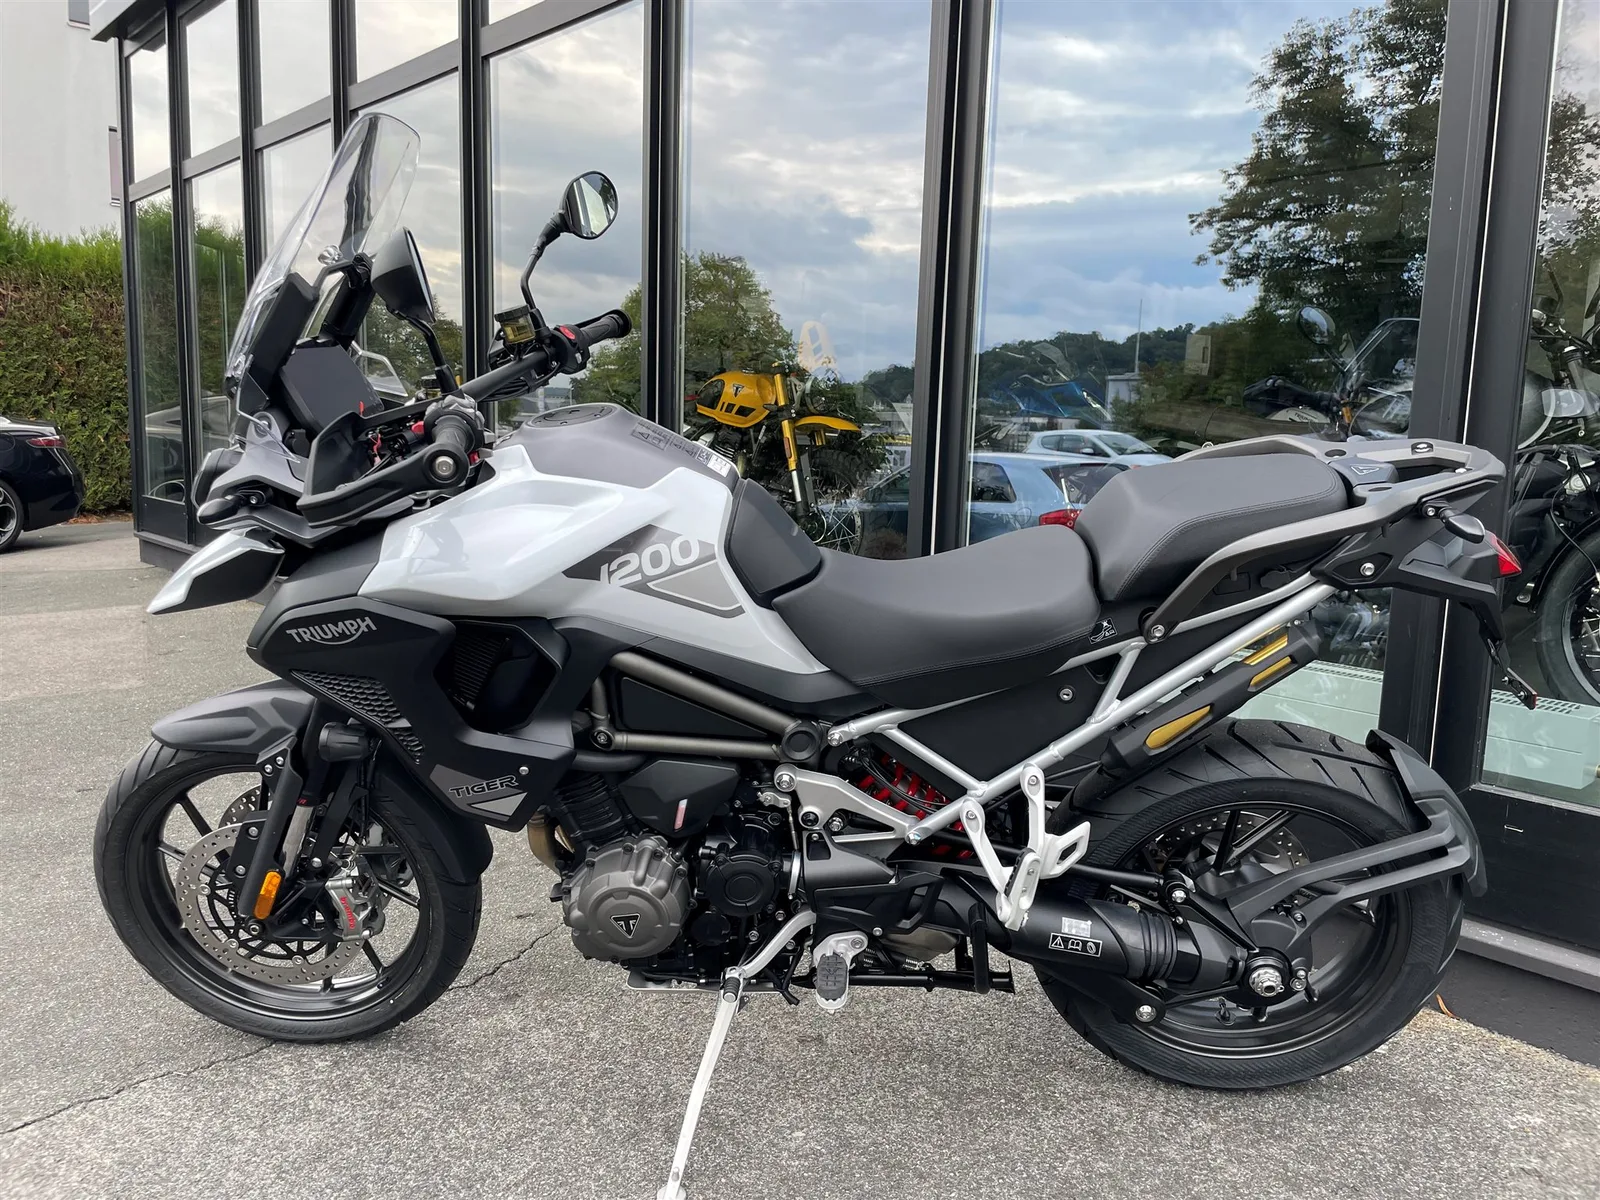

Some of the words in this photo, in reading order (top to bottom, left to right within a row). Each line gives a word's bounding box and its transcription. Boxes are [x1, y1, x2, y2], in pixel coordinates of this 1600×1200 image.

[599, 534, 700, 584] 1200
[286, 616, 377, 645] TRIUMPH
[449, 775, 518, 797] TIGER
